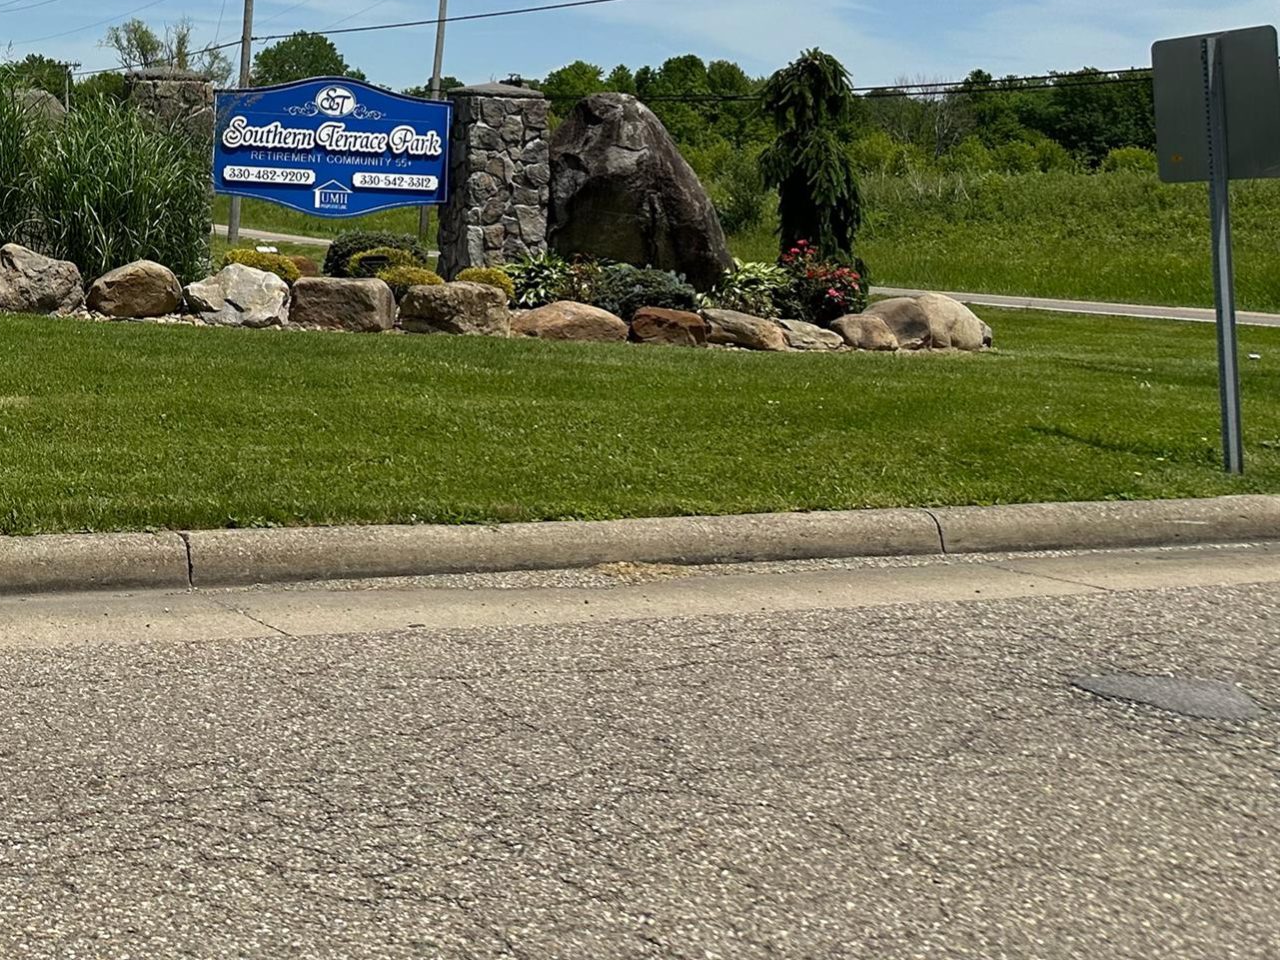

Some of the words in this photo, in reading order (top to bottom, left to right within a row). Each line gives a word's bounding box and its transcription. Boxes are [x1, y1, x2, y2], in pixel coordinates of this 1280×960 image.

[223, 117, 314, 148] Southern
[316, 123, 387, 152] Terrace
[390, 126, 441, 154] Park
[250, 150, 322, 163] RETIREMENT
[326, 154, 391, 167] COMMUNITY
[228, 167, 310, 183] 330-482-9209
[359, 174, 431, 189] 330-542-3312
